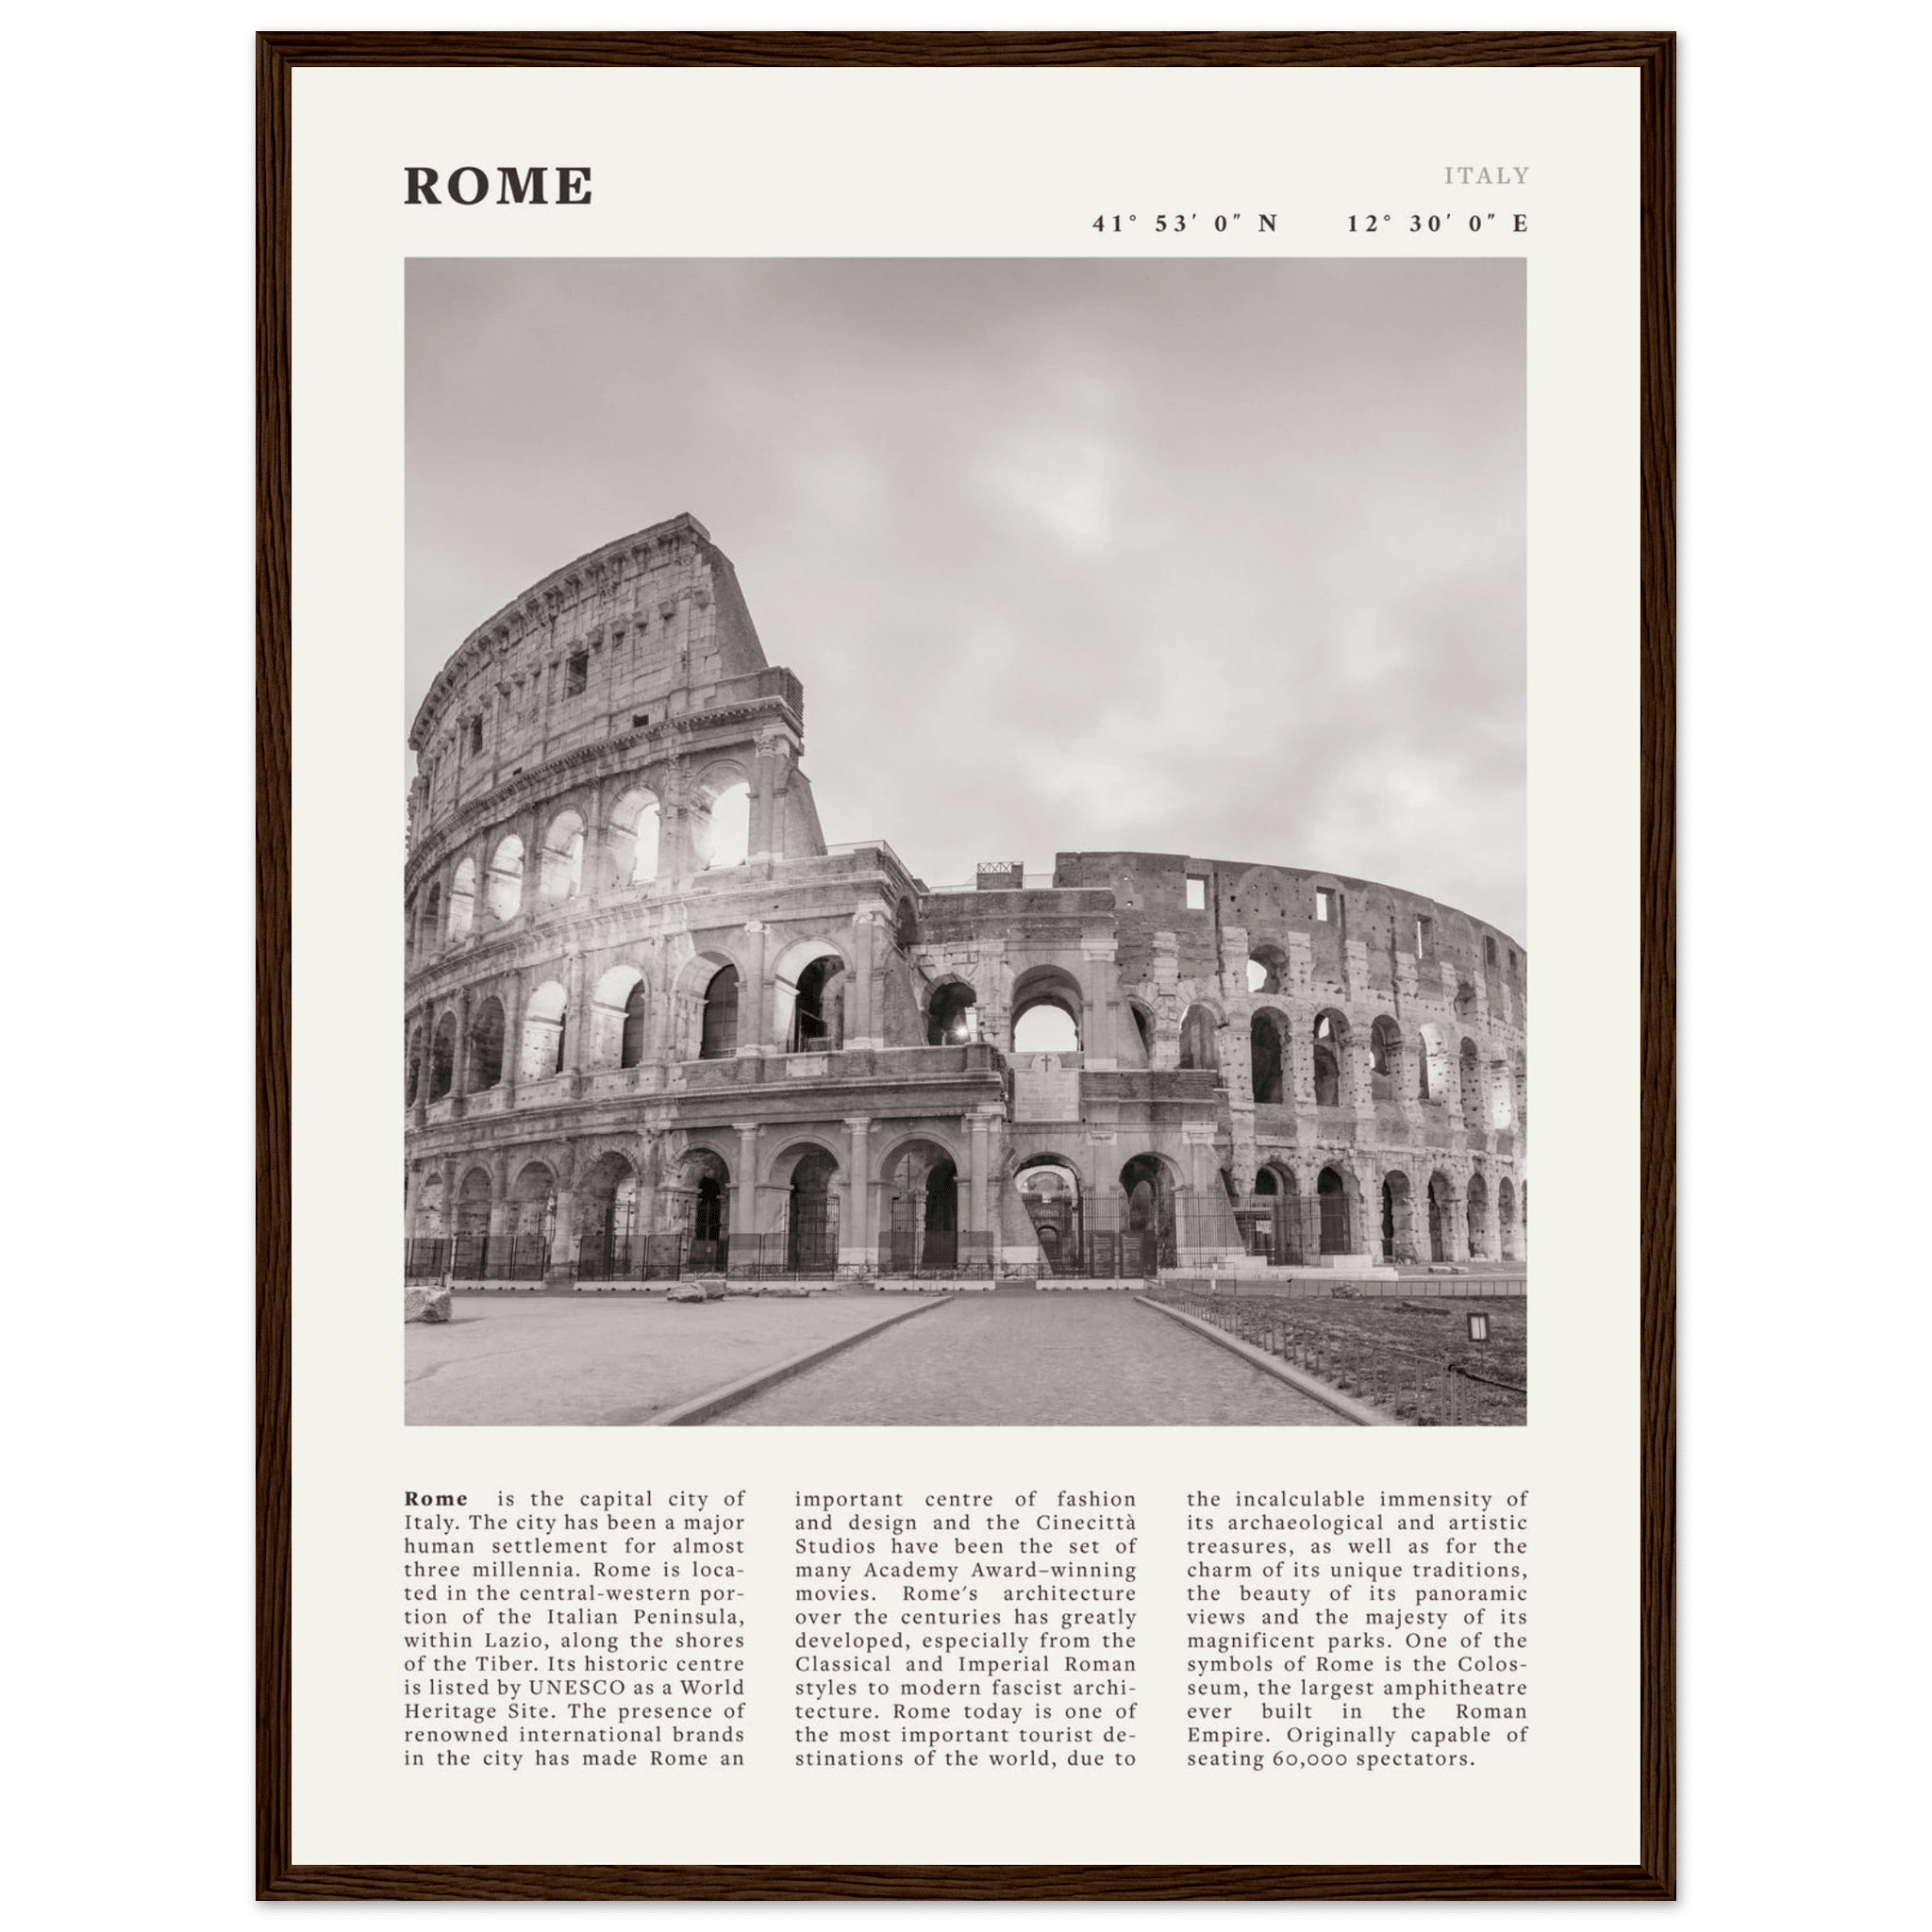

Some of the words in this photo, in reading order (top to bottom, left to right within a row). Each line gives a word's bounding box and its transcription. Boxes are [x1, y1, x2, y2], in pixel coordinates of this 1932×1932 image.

[403, 165, 592, 206] ROME
[1444, 166, 1530, 185] ITALY
[1257, 213, 1277, 233] N
[1512, 213, 1528, 233] E
[404, 1491, 468, 1507] Rome
[497, 1490, 515, 1507] is
[530, 1490, 564, 1507] the
[579, 1490, 652, 1512] capital
[668, 1490, 708, 1512] city
[724, 1489, 747, 1507] of
[795, 1491, 904, 1512] important
[924, 1493, 993, 1507] centre
[1014, 1490, 1038, 1507] of
[1057, 1490, 1136, 1507] fashion
[1187, 1490, 1221, 1507] the
[1236, 1490, 1365, 1507] incalculable
[1380, 1491, 1492, 1512] immensity
[1507, 1490, 1529, 1507] of
[405, 1513, 460, 1536] Italy.
[468, 1513, 508, 1530] The
[516, 1513, 557, 1536] city
[564, 1513, 599, 1530] has
[607, 1513, 657, 1530] been
[664, 1518, 675, 1530] a
[684, 1514, 745, 1536] major
[795, 1513, 833, 1531] and
[848, 1513, 917, 1536] design
[933, 1513, 971, 1531] and
[986, 1513, 1021, 1531] the
[1036, 1513, 1136, 1531] Cinecittà
[1187, 1514, 1214, 1531] its
[1227, 1513, 1383, 1536] archaeological
[1397, 1513, 1435, 1531] and
[1448, 1514, 1527, 1531] artistic
[404, 1537, 475, 1555] human
[491, 1537, 608, 1555] settlement
[625, 1537, 657, 1555] for
[673, 1537, 744, 1555] almost
[404, 1560, 460, 1577] three
[473, 1560, 580, 1577] millennia.
[593, 1561, 651, 1577] Rome
[663, 1560, 680, 1578] is
[692, 1560, 744, 1577] loca-
[795, 1565, 852, 1583] many
[863, 1560, 958, 1583] Academy
[1187, 1560, 1252, 1578] charm
[1262, 1560, 1286, 1578] of
[1293, 1561, 1320, 1578] its
[1330, 1561, 1403, 1583] unique
[1412, 1560, 1527, 1581] traditions,
[404, 1584, 438, 1601] ted
[447, 1584, 467, 1601] in
[476, 1584, 510, 1601] the
[519, 1584, 691, 1602] central-western
[700, 1589, 744, 1607] por-
[795, 1585, 876, 1602] movies.
[1003, 1584, 1136, 1602] architecture
[1187, 1584, 1221, 1602] the
[1239, 1584, 1311, 1607] beauty
[1329, 1584, 1353, 1602] of
[1369, 1585, 1396, 1602] its
[1415, 1585, 1527, 1607] panoramic
[404, 1607, 447, 1625] tion
[462, 1607, 485, 1625] of
[498, 1607, 532, 1625] the
[547, 1607, 618, 1625] Italian
[634, 1607, 744, 1628] Peninsula,
[795, 1612, 842, 1625] over
[854, 1607, 888, 1625] the
[901, 1608, 1001, 1625] centuries
[1014, 1607, 1049, 1625] has
[1060, 1607, 1137, 1630] greatly
[404, 1631, 473, 1648] within
[485, 1631, 550, 1651] Lazio,
[560, 1631, 619, 1654] along
[629, 1631, 663, 1649] the
[675, 1631, 744, 1649] shores
[795, 1631, 910, 1654] developed,
[922, 1631, 1029, 1654] especially
[1040, 1631, 1091, 1649] from
[1102, 1631, 1136, 1649] the
[1188, 1631, 1315, 1654] magnificent
[1327, 1631, 1392, 1654] parks.
[1405, 1632, 1447, 1649] One
[1459, 1631, 1483, 1649] of
[1493, 1631, 1527, 1649] the
[404, 1654, 427, 1672] of
[433, 1655, 467, 1672] the
[475, 1655, 539, 1672] Tiber.
[547, 1656, 576, 1672] Its
[584, 1655, 668, 1672] historic
[675, 1658, 744, 1672] centre
[795, 1655, 891, 1673] Classical
[906, 1655, 943, 1673] and
[958, 1655, 1049, 1677] Imperial
[1064, 1656, 1136, 1673] Roman
[1187, 1655, 1274, 1677] symbols
[1283, 1655, 1307, 1673] of
[1316, 1656, 1374, 1673] Rome
[1385, 1655, 1402, 1673] is
[1412, 1655, 1447, 1673] the
[1457, 1655, 1527, 1673] Colos-
[795, 1678, 858, 1701] styles
[868, 1682, 890, 1696] to
[900, 1678, 981, 1696] modern
[991, 1678, 1062, 1696] fascist
[1073, 1678, 1136, 1696] archi-
[1187, 1683, 1249, 1699] seum,
[1257, 1678, 1291, 1696] the
[1301, 1678, 1374, 1701] largest
[1383, 1678, 1527, 1701] amphitheatre
[405, 1702, 497, 1724] Heritage
[508, 1702, 556, 1719] Site.
[567, 1702, 607, 1719] The
[618, 1707, 712, 1724] presence
[724, 1701, 747, 1720] of
[1187, 1707, 1233, 1720] ever
[1261, 1702, 1312, 1720] built
[1342, 1702, 1362, 1720] in
[1391, 1702, 1425, 1720] the
[1456, 1703, 1527, 1720] Roman
[404, 1725, 508, 1742] renowned
[519, 1725, 661, 1742] international
[672, 1725, 744, 1742] brands
[794, 1725, 829, 1743] the
[839, 1729, 891, 1743] most
[901, 1726, 1009, 1748] important
[1019, 1726, 1092, 1743] tourist
[1103, 1725, 1136, 1743] de-
[1188, 1726, 1271, 1748] Empire.
[1287, 1725, 1396, 1748] Originally
[1410, 1725, 1491, 1748] capable
[1507, 1725, 1529, 1742] of
[795, 1749, 904, 1767] stinations
[914, 1749, 937, 1767] of
[944, 1749, 978, 1767] the
[989, 1749, 1057, 1770] world,
[1067, 1749, 1105, 1767] due
[1114, 1753, 1137, 1767] to
[1187, 1749, 1265, 1772] seating
[1273, 1750, 1348, 1770] 60,000
[1357, 1752, 1475, 1772] spectators.
